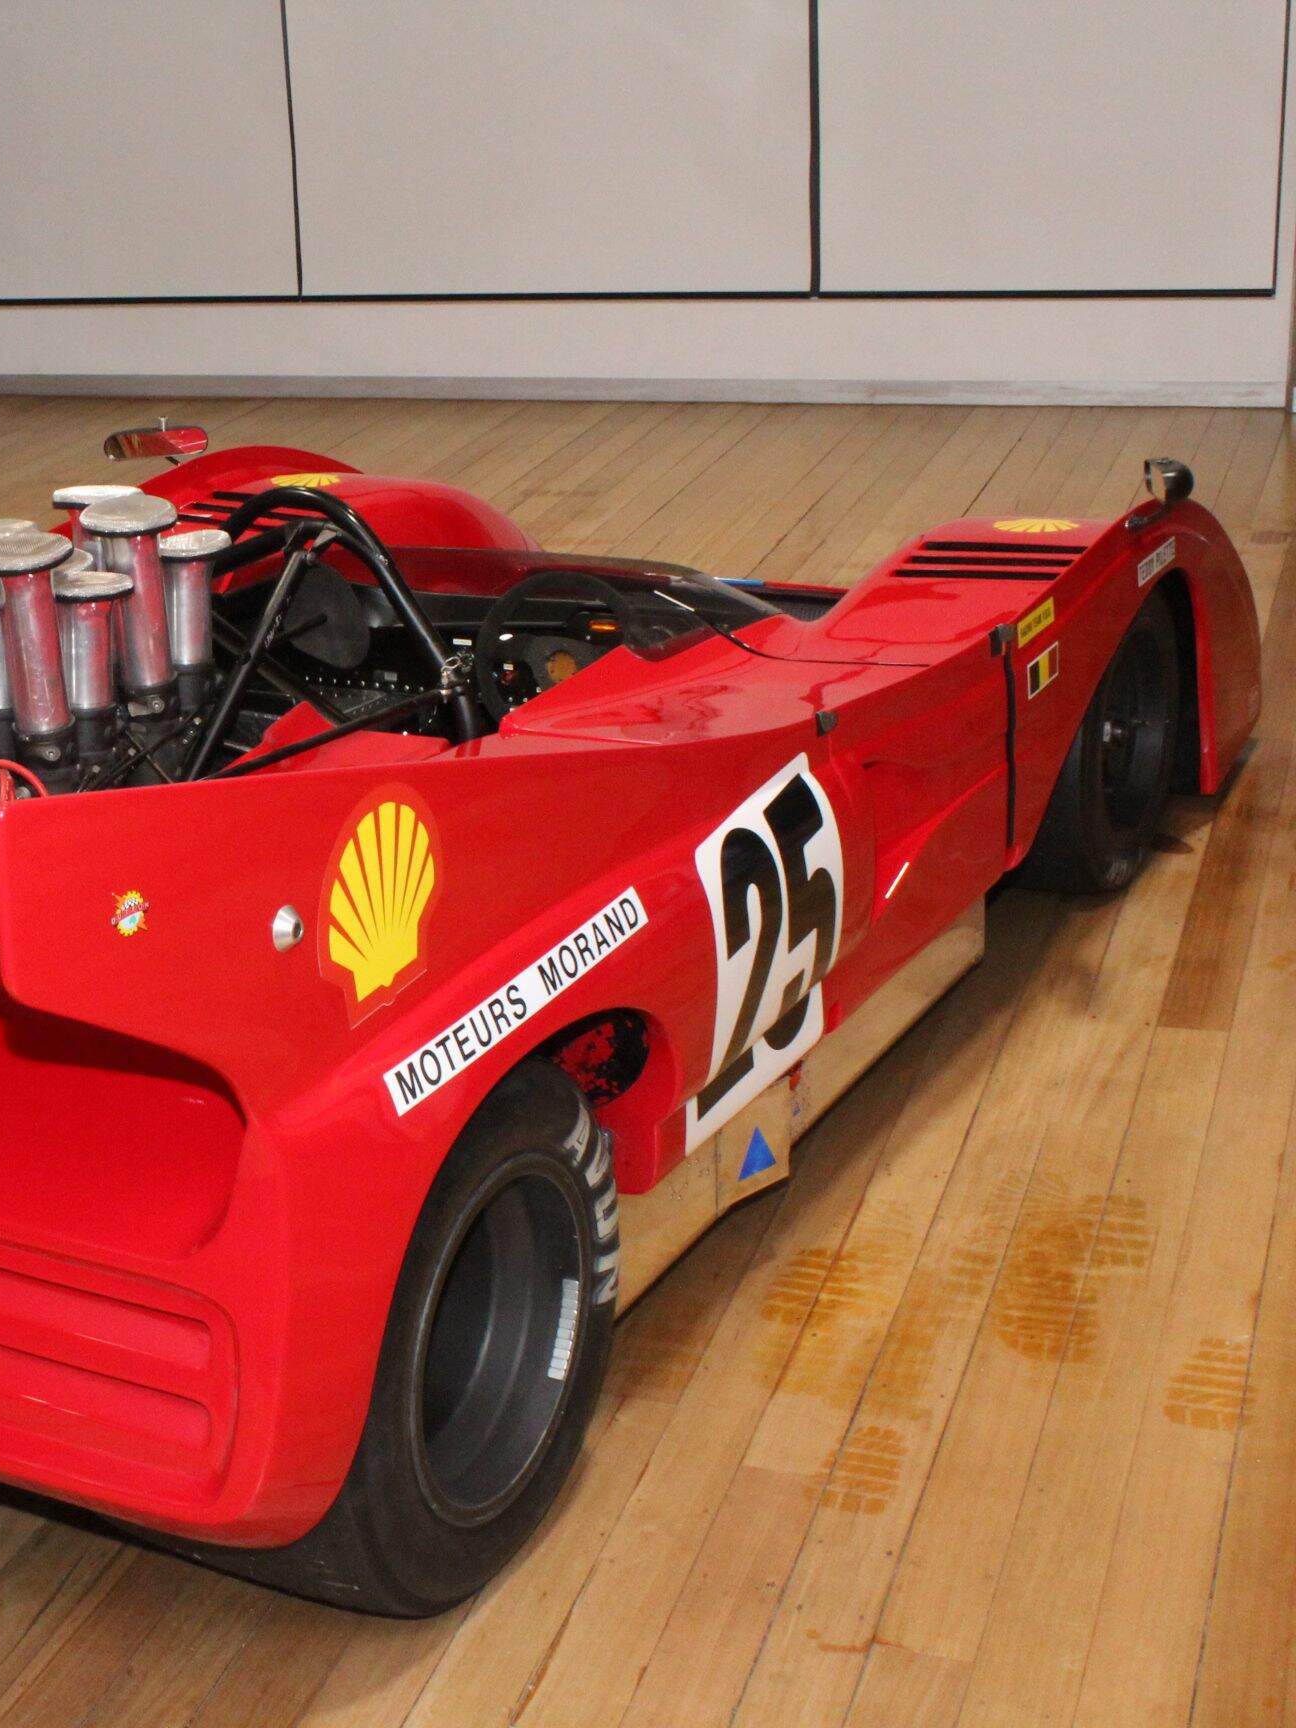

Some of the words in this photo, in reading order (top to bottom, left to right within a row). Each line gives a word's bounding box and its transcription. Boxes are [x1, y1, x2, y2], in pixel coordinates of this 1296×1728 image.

[394, 984, 528, 1105] MOTEURS
[537, 897, 640, 996] MORAND
[697, 773, 837, 1122] 25
